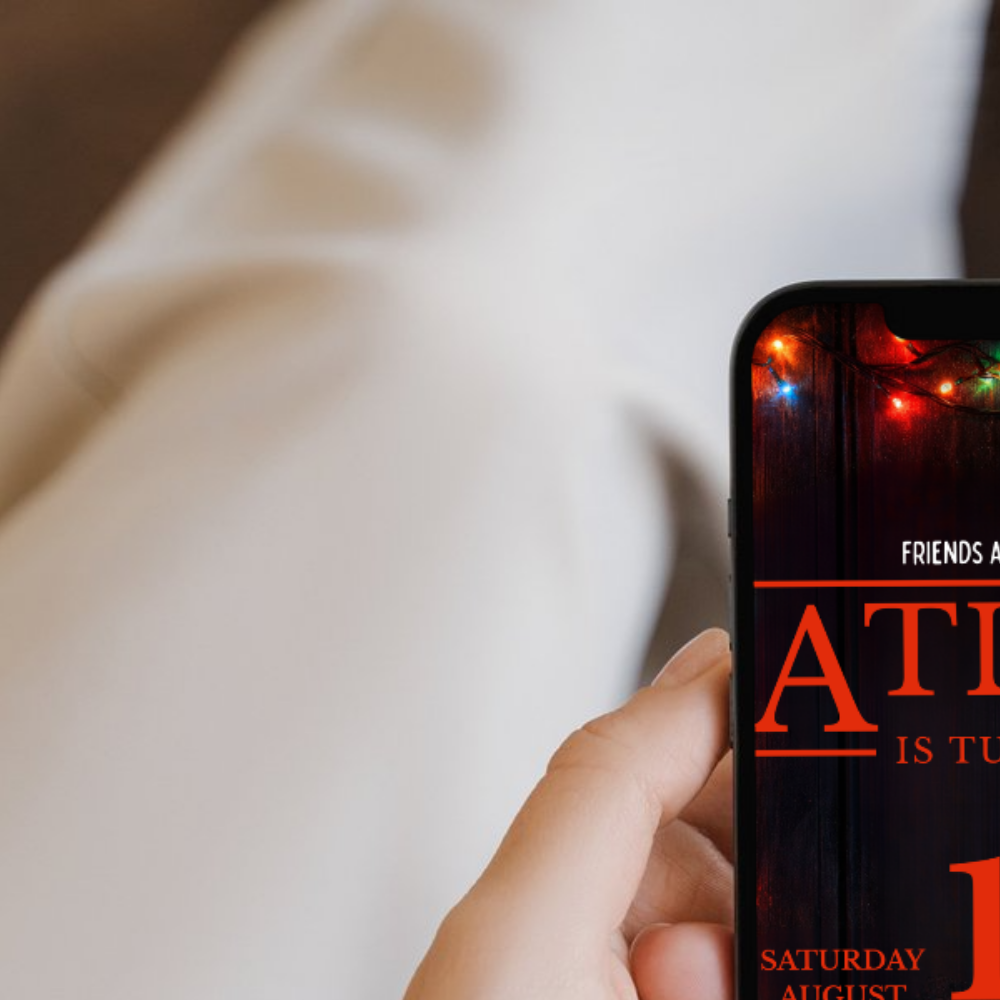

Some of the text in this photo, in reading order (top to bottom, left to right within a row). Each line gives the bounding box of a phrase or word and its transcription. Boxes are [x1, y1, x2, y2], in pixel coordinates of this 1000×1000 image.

[902, 540, 983, 566] FRIENDS
[896, 736, 933, 764] IS
[760, 948, 925, 972] SATURDAY
